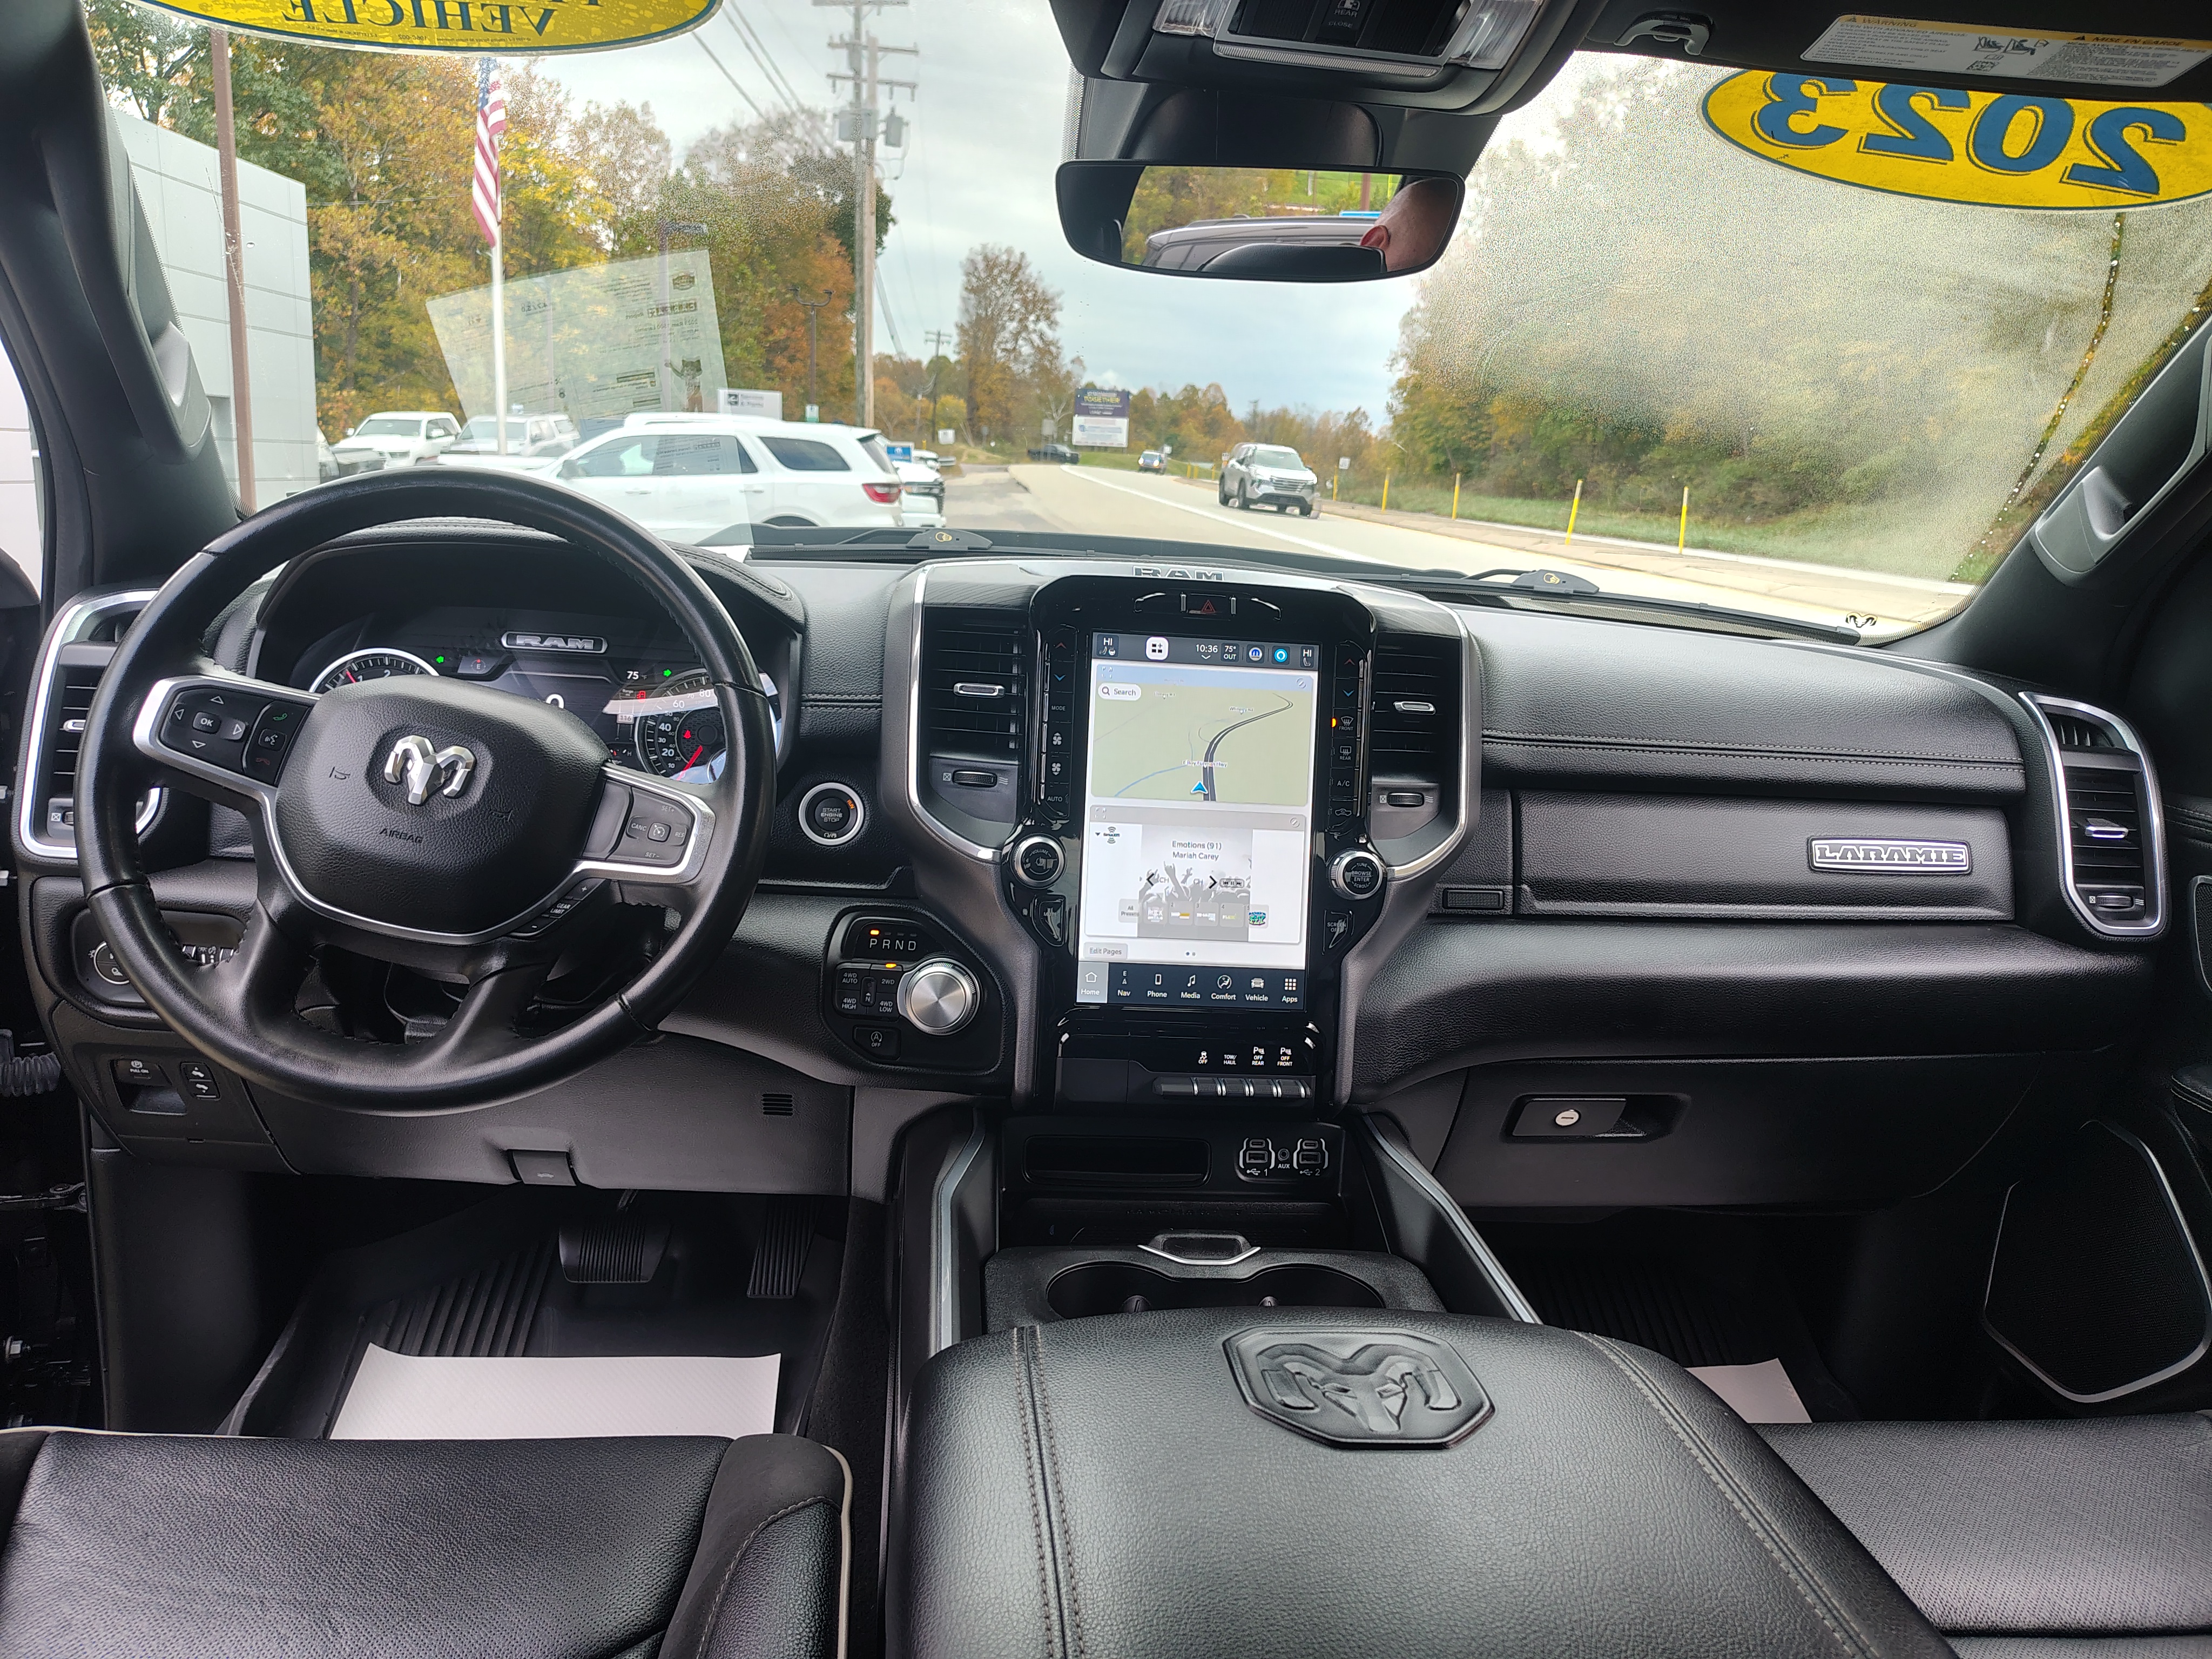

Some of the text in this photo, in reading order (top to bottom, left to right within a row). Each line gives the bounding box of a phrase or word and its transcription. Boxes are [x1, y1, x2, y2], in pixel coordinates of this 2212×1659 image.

[1334, 9, 1358, 18] REAR
[1328, 21, 1353, 29] CLOSE
[1863, 17, 1917, 27] WARNING
[1134, 566, 1224, 581] RAM
[516, 635, 594, 649] RAM
[1103, 638, 1112, 646] HI
[1196, 644, 1218, 653] 10:36
[1303, 649, 1312, 657] HI
[384, 670, 390, 678] 2
[627, 671, 639, 680] 75
[699, 689, 711, 697] 80
[1114, 688, 1136, 696] Search
[201, 718, 213, 727] OK
[846, 799, 855, 810] RUN
[631, 822, 647, 831] CANC
[379, 828, 423, 843] AIRBAG
[1172, 840, 1222, 850] Emotions (91)
[1198, 853, 1219, 861] Carey
[1815, 845, 1966, 864] LARAMIE
[869, 938, 916, 951] P R N D
[1103, 948, 1122, 956] Pages
[1147, 991, 1168, 999] Phone
[1245, 994, 1269, 1002] Vehicle
[1282, 996, 1298, 1004] Apps
